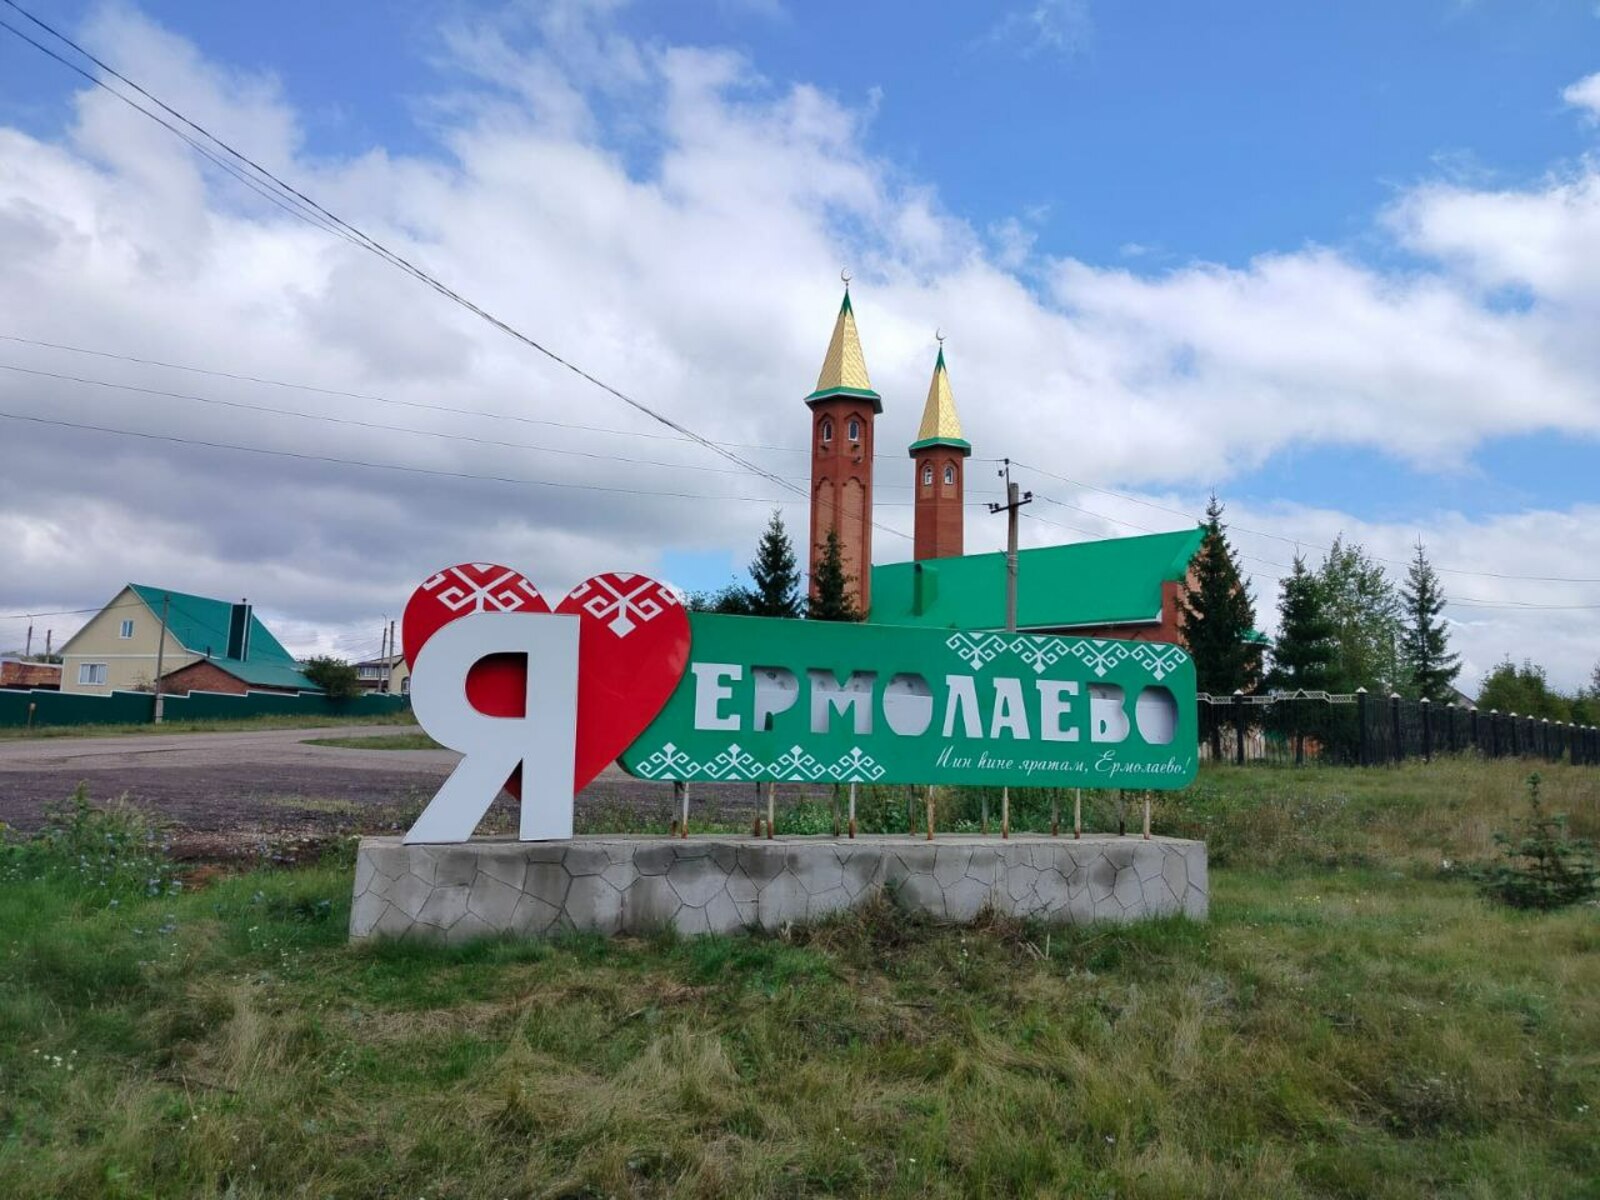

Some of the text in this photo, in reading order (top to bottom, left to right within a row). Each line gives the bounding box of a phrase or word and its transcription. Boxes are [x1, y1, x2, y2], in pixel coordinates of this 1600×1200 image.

[402, 611, 581, 845] Я
[691, 662, 1180, 745] ЕРМОЛАЕВО
[1018, 759, 1088, 777] яратам,
[1094, 749, 1191, 779] Ермолаево!
